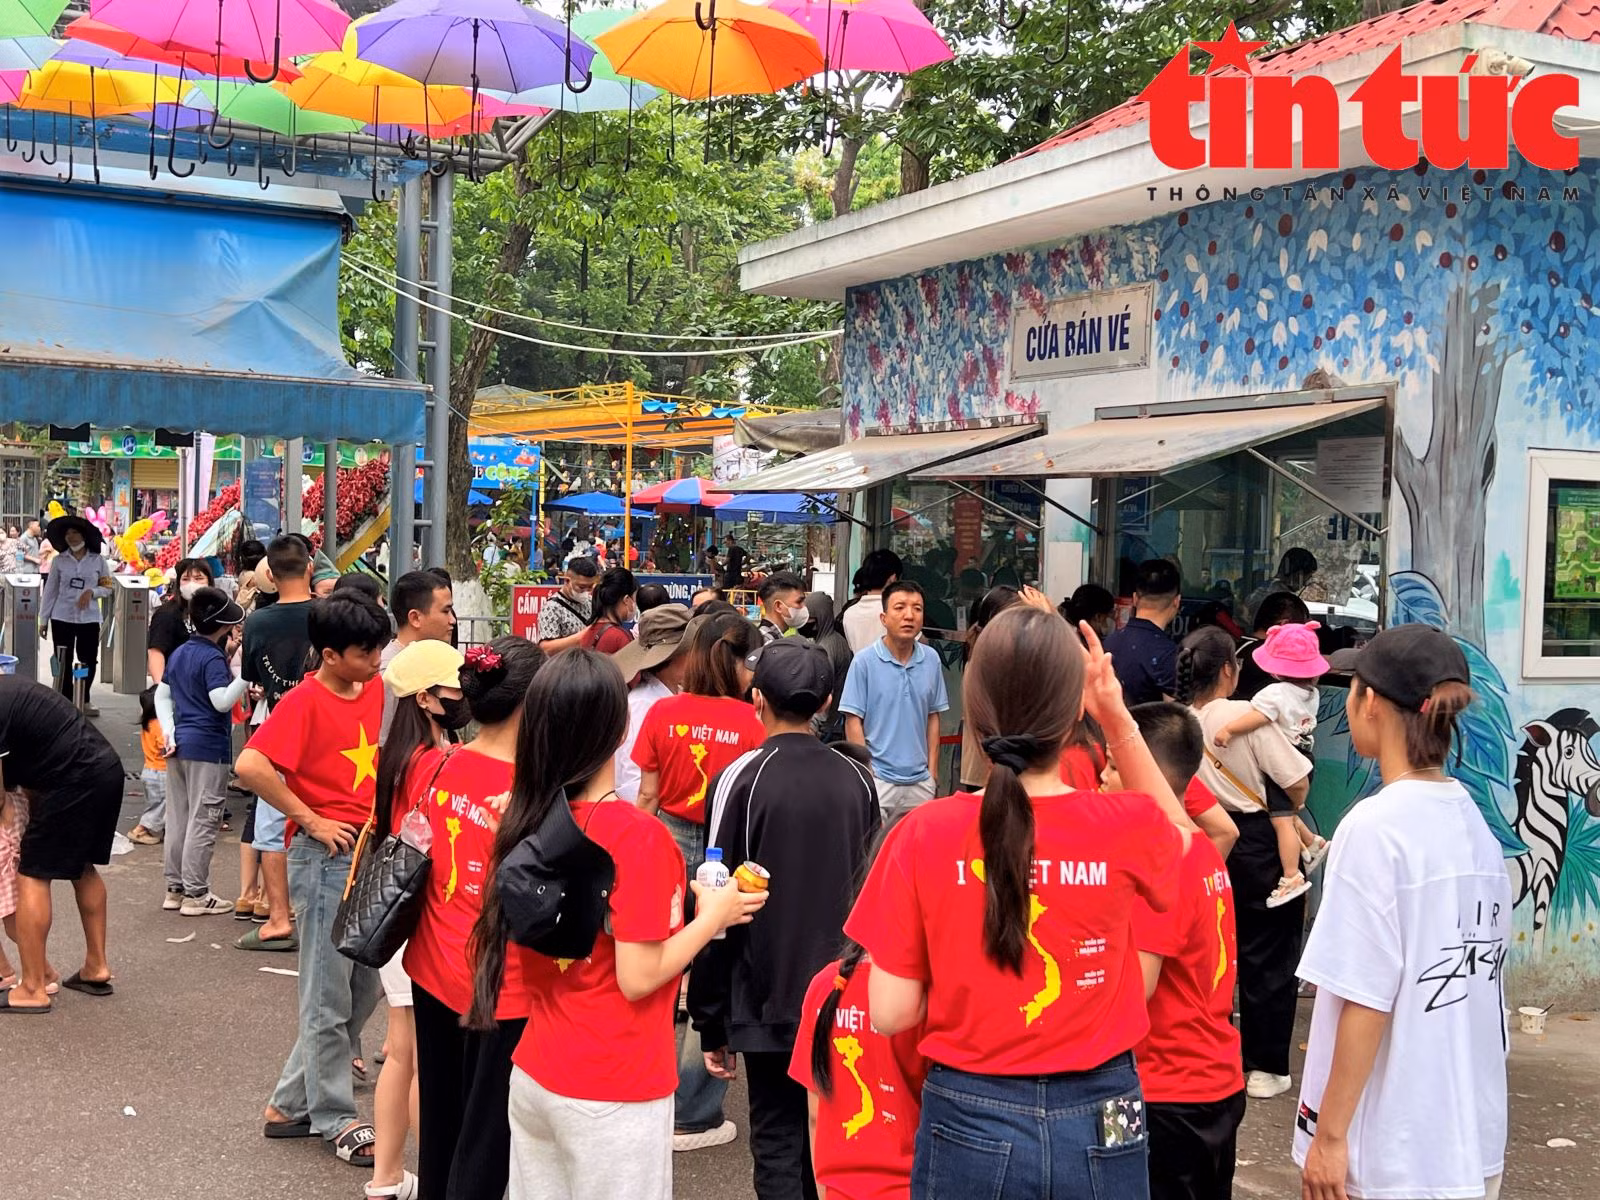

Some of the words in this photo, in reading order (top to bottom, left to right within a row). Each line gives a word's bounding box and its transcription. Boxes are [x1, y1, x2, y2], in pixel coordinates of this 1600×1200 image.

[1065, 311, 1102, 357] BÁN
[1108, 304, 1131, 351] VÉ
[517, 589, 538, 614] CẤM
[668, 724, 674, 738] I
[691, 723, 713, 743] VIỆT
[715, 728, 740, 745] NAM
[956, 860, 966, 885] I
[1060, 860, 1108, 886] NAM
[836, 1004, 866, 1034] VIỆT
